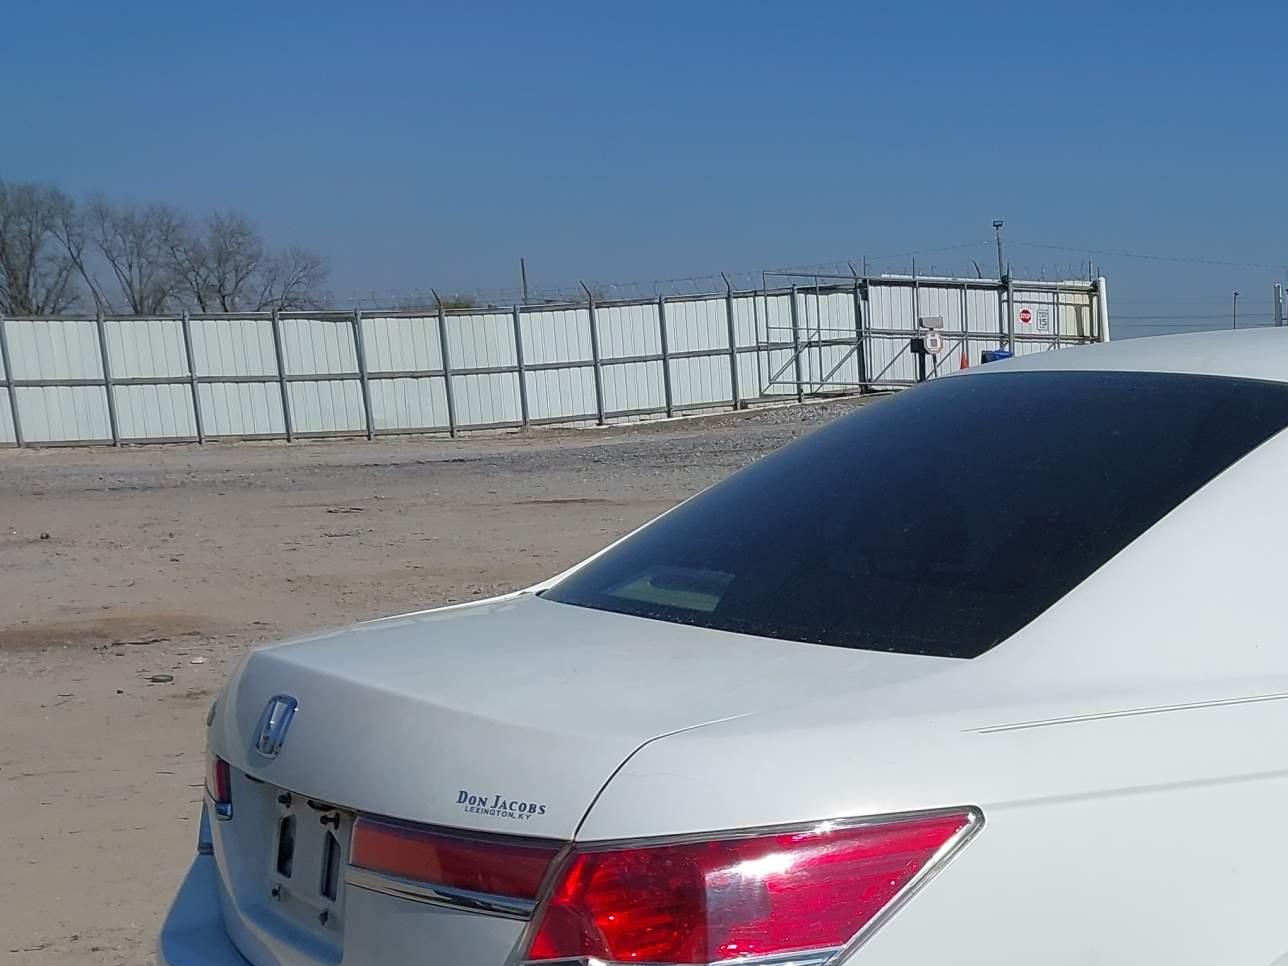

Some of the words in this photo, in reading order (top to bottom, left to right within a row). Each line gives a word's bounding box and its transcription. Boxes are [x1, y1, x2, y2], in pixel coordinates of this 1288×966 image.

[1039, 318, 1048, 327] 15
[456, 790, 488, 808] DON
[491, 795, 546, 815] JACOBS
[464, 805, 516, 819] LEXINGTON,
